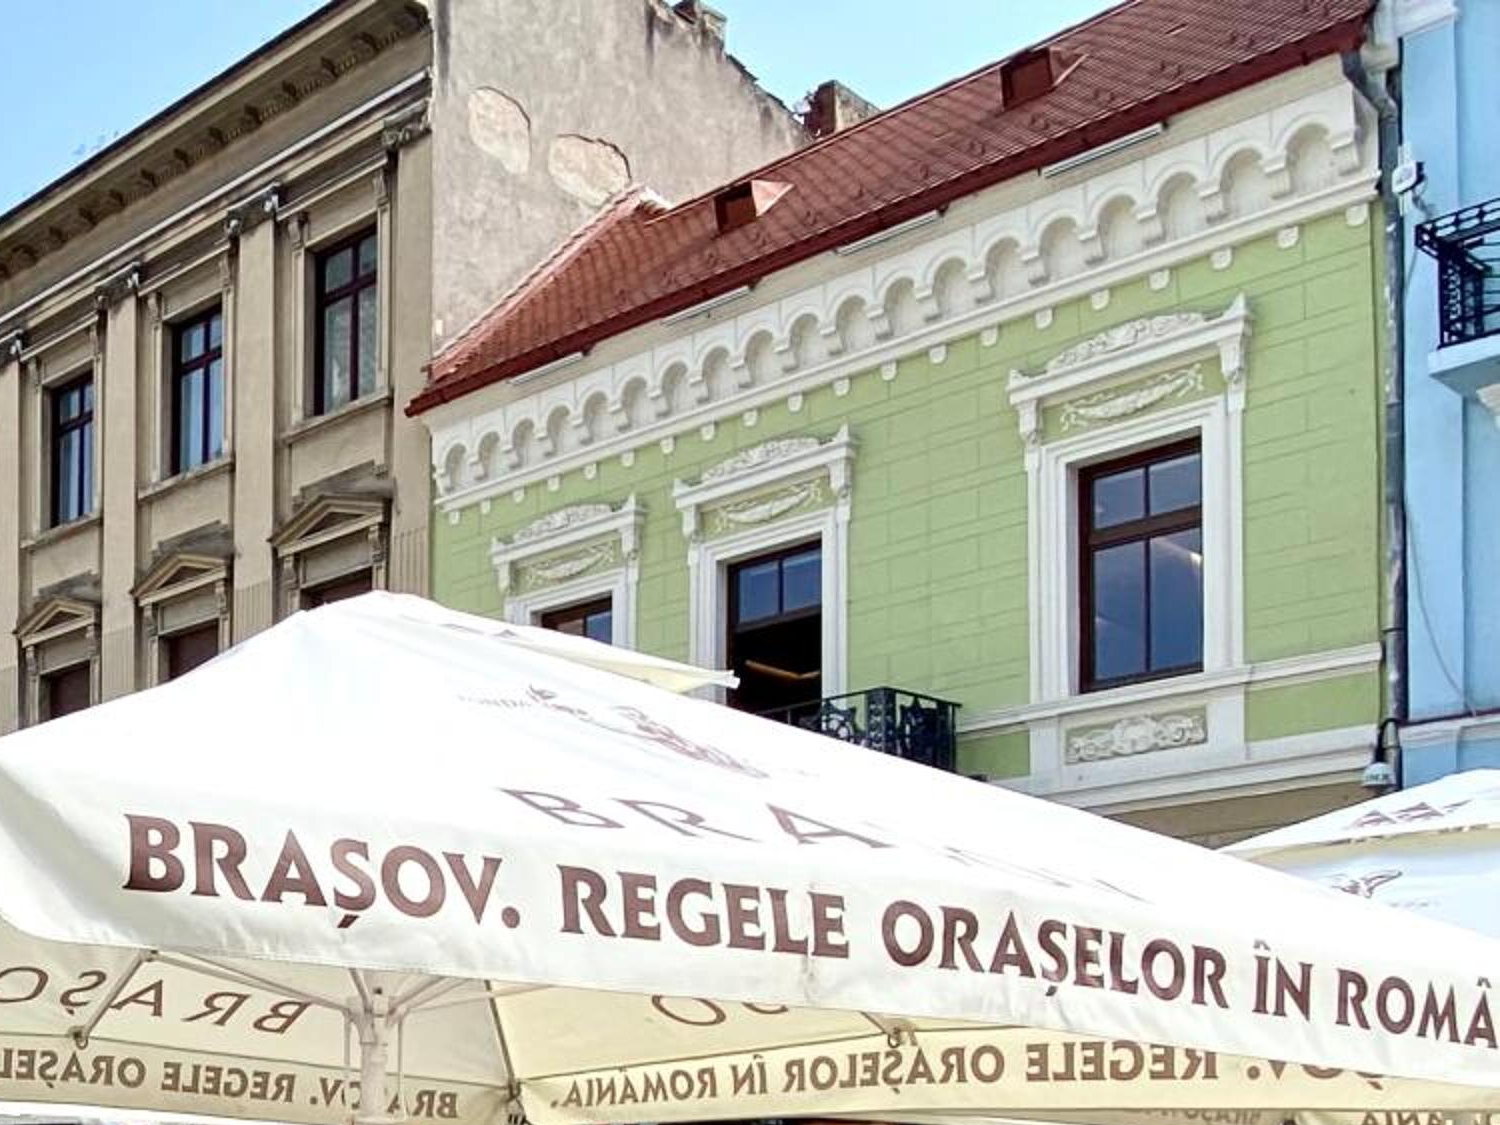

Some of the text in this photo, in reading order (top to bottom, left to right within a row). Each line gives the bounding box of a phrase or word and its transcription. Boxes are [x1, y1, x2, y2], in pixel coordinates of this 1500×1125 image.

[122, 813, 521, 929] BRAȘOV.
[556, 864, 850, 960] REGELE
[881, 899, 1229, 1009] ORAȘELOR
[1251, 939, 1314, 1022] ÎN
[1334, 966, 1499, 1049] ROMÂ
